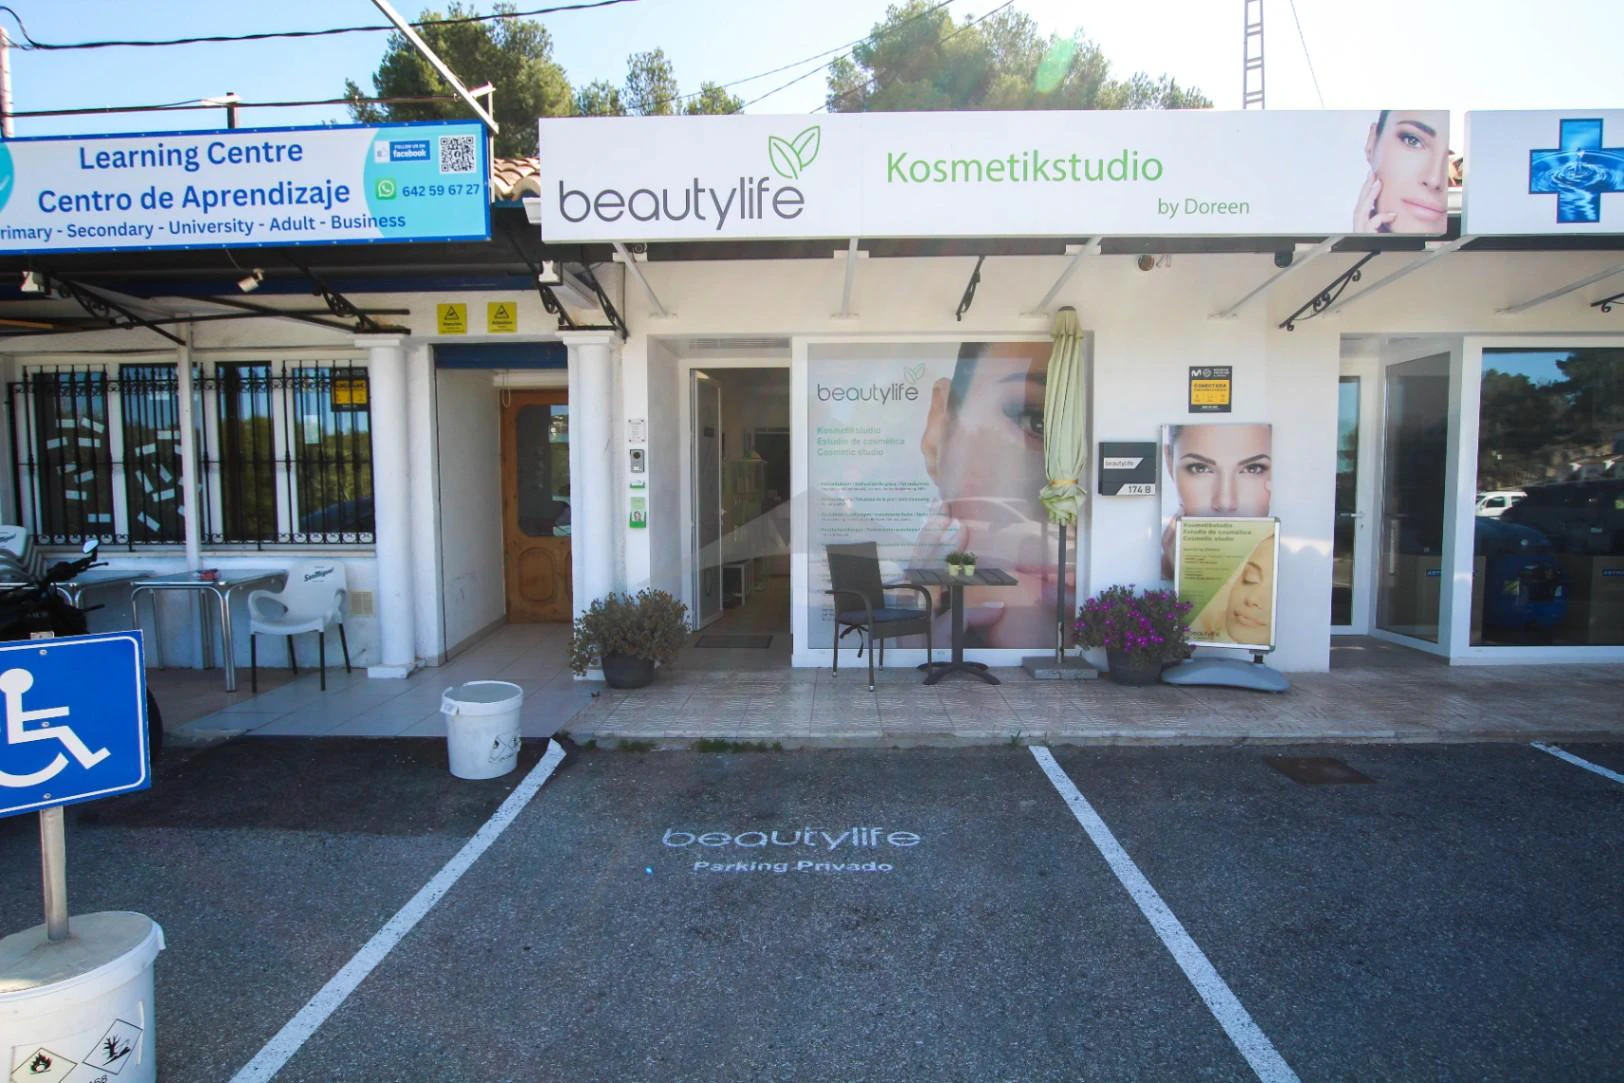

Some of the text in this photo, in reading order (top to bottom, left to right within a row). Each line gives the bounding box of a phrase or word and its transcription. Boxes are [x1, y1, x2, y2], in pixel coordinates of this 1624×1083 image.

[79, 141, 303, 172] Learning Centre
[393, 149, 426, 158] facebook
[887, 149, 1164, 183] Kosmetikstudio
[38, 180, 350, 214] Centro de Aprendizaje
[402, 184, 481, 197] 642 59 67 27
[559, 176, 805, 230] beautylife
[1158, 197, 1250, 219] by Doreen
[0, 225, 53, 243] rimary
[66, 222, 154, 240] Secondary
[168, 217, 254, 236] University
[269, 216, 316, 232] Adult
[331, 213, 406, 229] Business
[817, 383, 919, 405] beautylife
[858, 448, 884, 456] studio
[1128, 485, 1143, 494] 174
[662, 827, 921, 850] beautylife
[693, 859, 893, 873] Parking Privado
